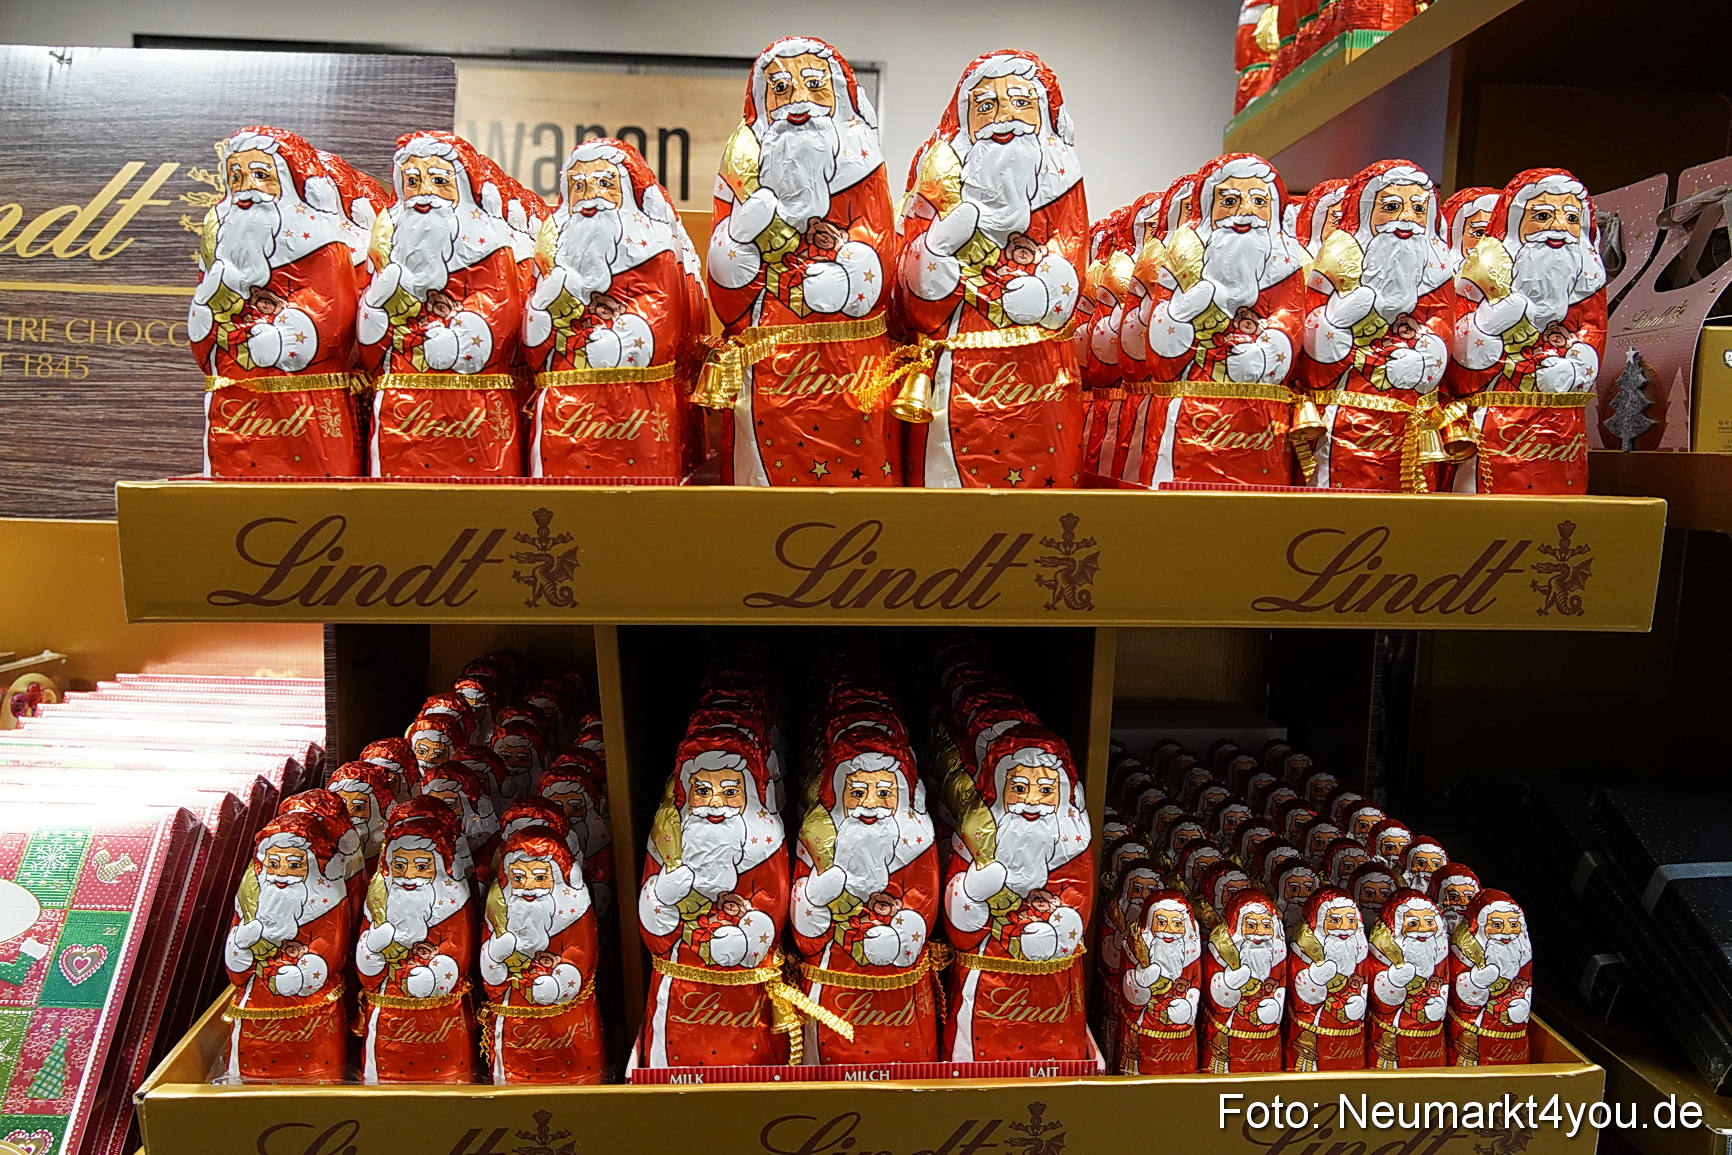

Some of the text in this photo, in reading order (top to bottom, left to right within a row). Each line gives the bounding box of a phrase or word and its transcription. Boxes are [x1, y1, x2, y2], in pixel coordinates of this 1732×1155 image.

[18, 353, 90, 380] 1845
[758, 351, 877, 395] Lindt
[211, 398, 316, 437] Lindt
[383, 400, 487, 439] Lindt
[544, 402, 649, 441] Lindt
[1336, 417, 1404, 452] Lin
[1483, 424, 1583, 462] Lindt
[206, 515, 507, 607] Lindt
[742, 519, 1034, 611] Lindt
[1250, 526, 1533, 616] Lindt
[243, 1018, 321, 1042] Lindt
[379, 1017, 455, 1043] Lindt
[505, 1024, 577, 1049] Lindt
[670, 1067, 1060, 1085] MILK MILCH LAIT
